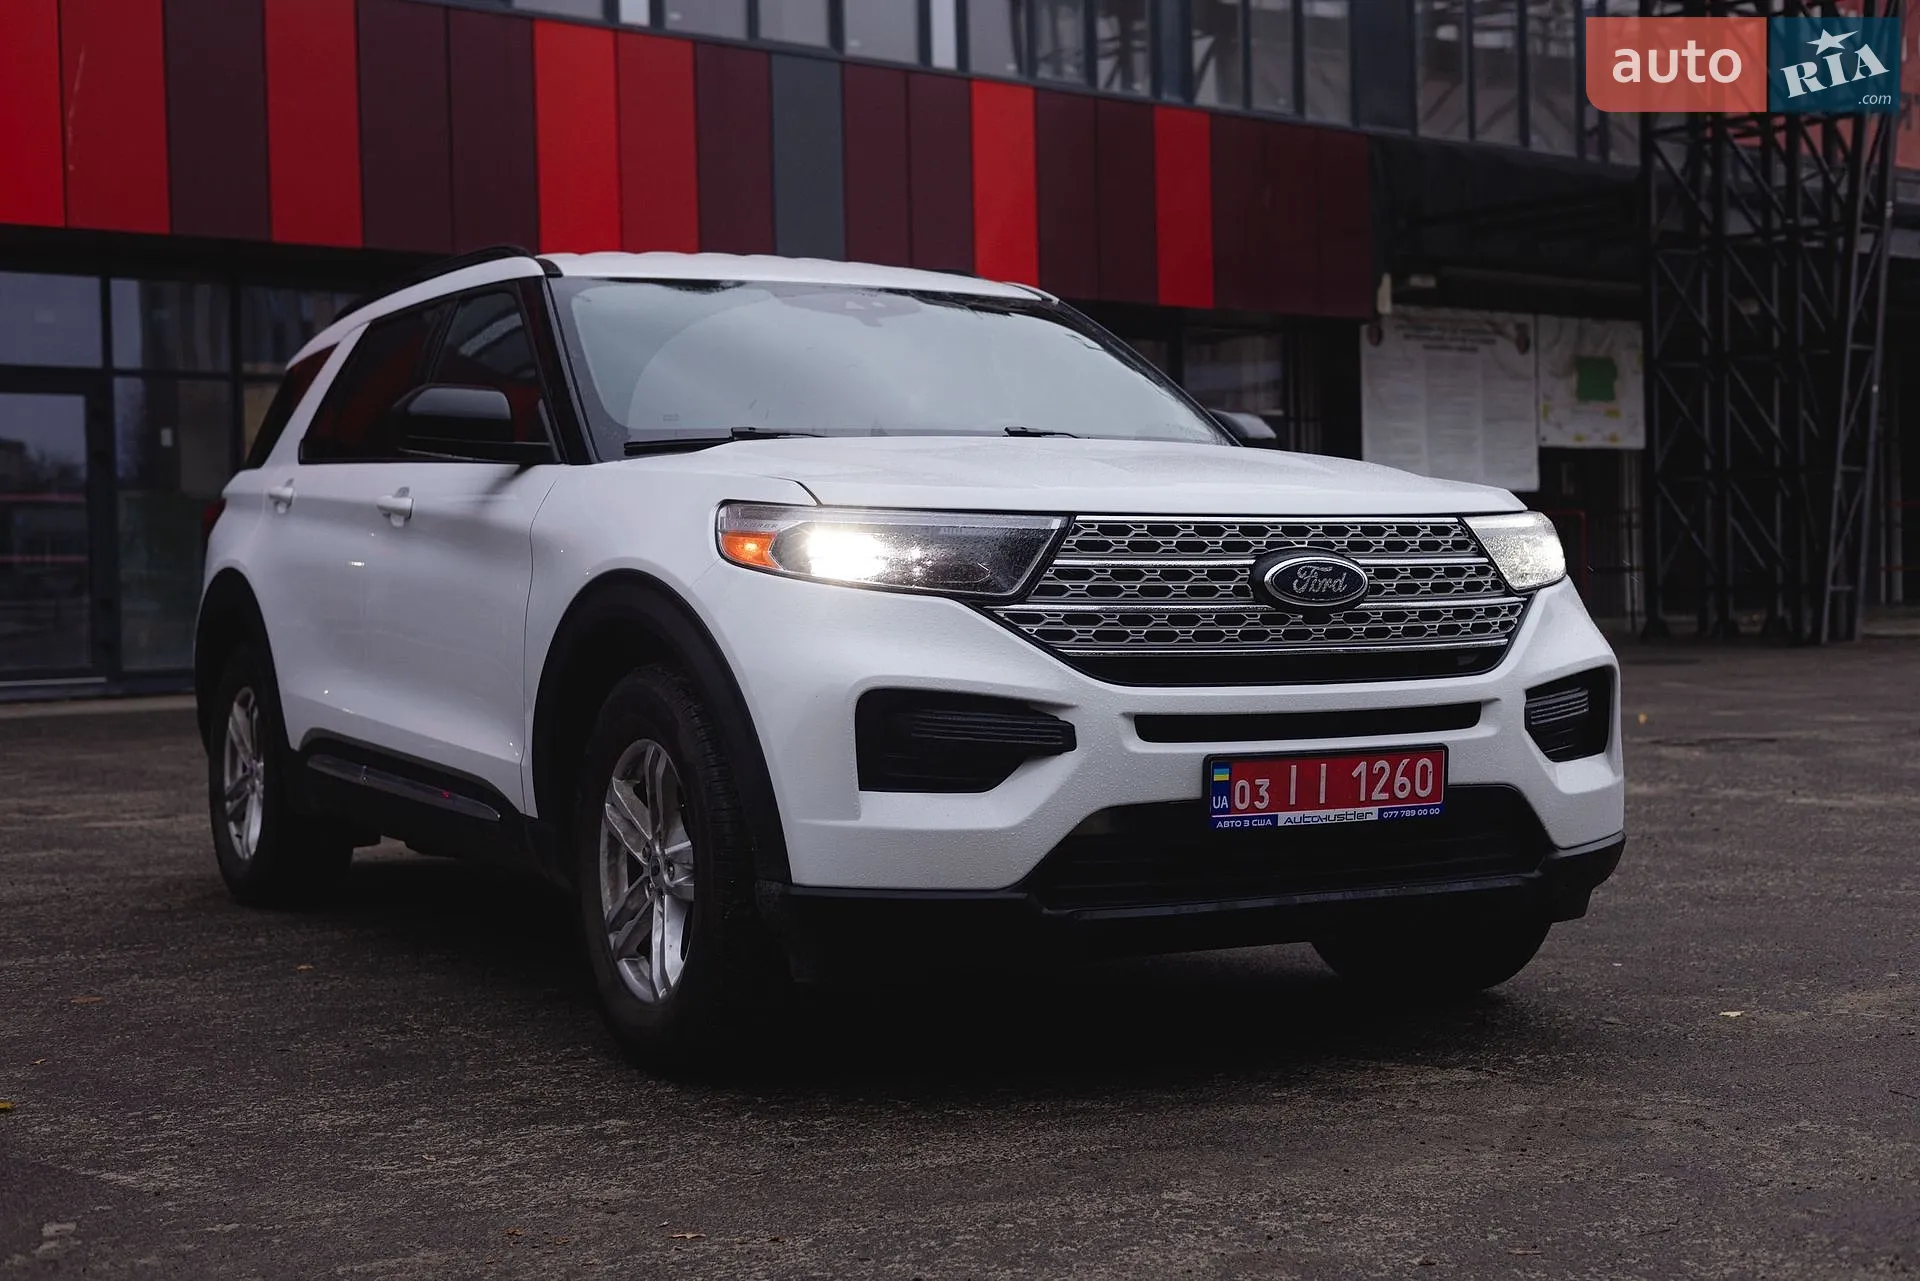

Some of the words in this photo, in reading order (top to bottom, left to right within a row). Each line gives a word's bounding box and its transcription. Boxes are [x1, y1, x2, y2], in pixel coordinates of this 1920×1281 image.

[1292, 565, 1348, 594] Ford
[1234, 778, 1270, 810] 03
[1351, 757, 1433, 802] 1260
[1212, 795, 1229, 809] UA
[1382, 810, 1399, 819] 077
[1417, 808, 1428, 816] 00
[1428, 807, 1440, 815] 00
